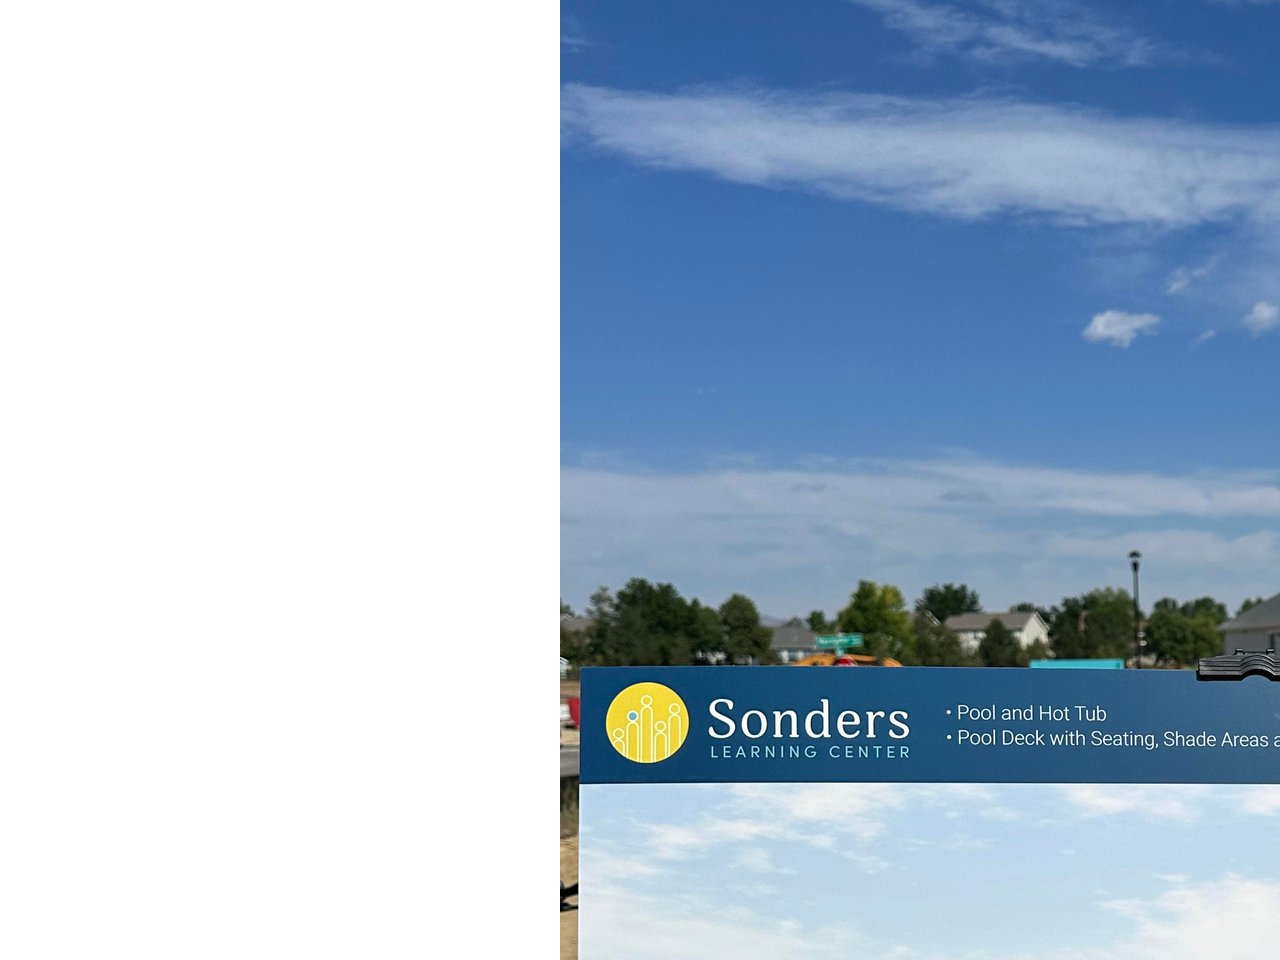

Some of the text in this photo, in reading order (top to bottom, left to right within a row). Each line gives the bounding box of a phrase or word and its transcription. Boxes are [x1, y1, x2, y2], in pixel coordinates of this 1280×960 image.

[708, 698, 910, 739] Sonders
[957, 704, 1107, 722] Pool and Hot Tub
[958, 729, 996, 746] Pool
[1002, 729, 1045, 746] Deck
[1049, 730, 1086, 746] with
[1091, 730, 1159, 751] Seating,
[1163, 730, 1217, 747] Shade
[1220, 731, 1269, 748] Areas
[711, 745, 910, 759] LEARNING CENTER
